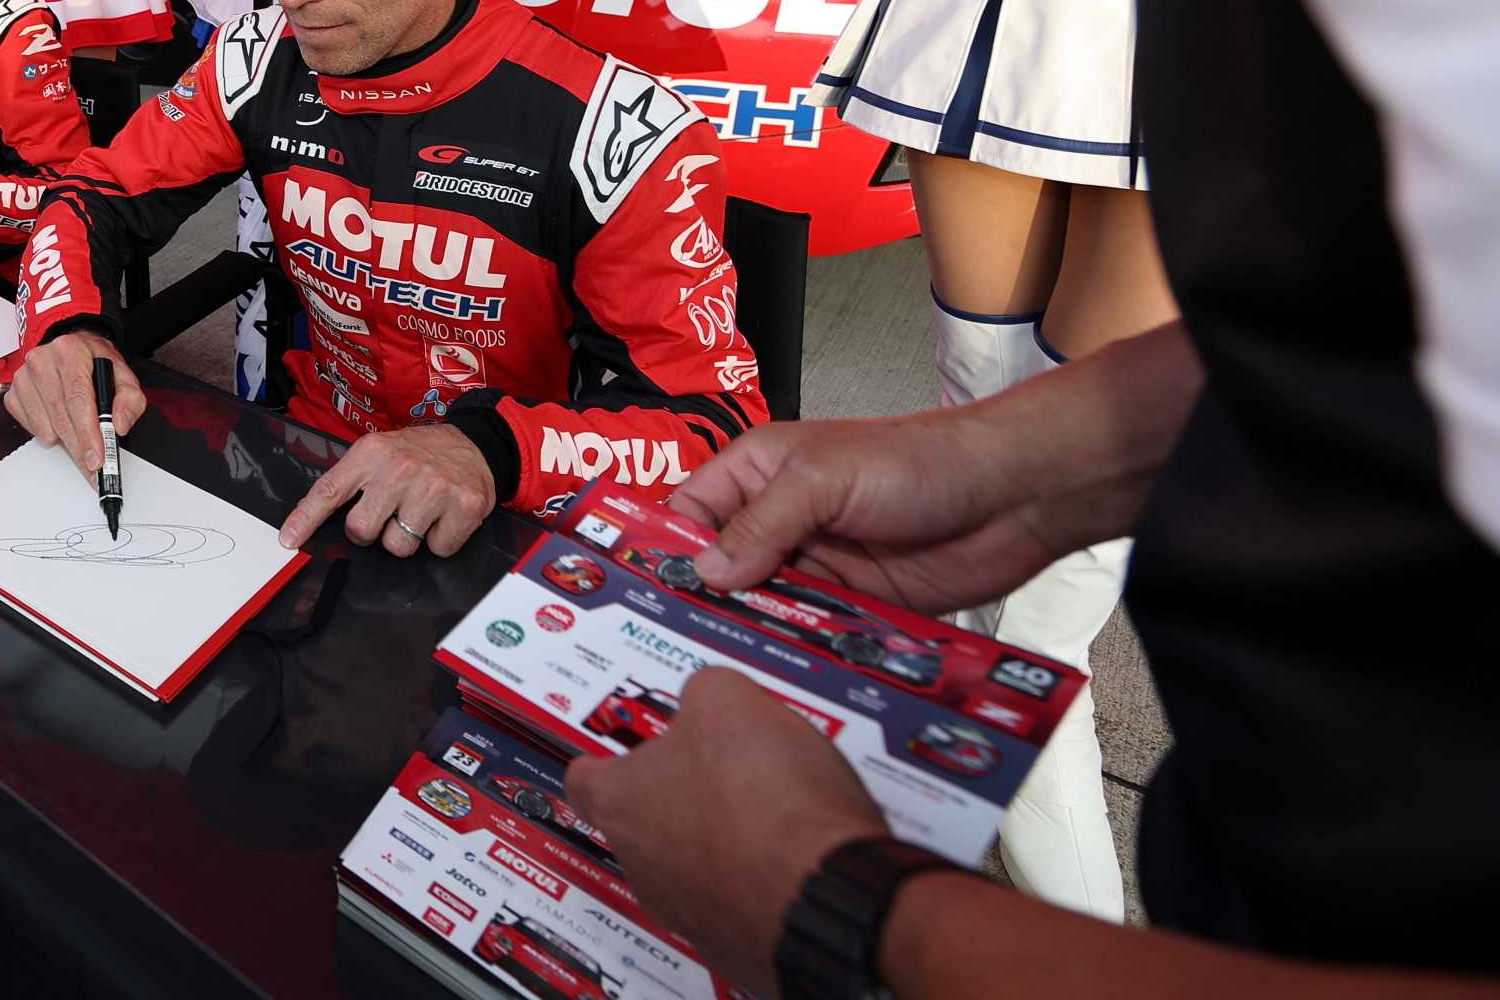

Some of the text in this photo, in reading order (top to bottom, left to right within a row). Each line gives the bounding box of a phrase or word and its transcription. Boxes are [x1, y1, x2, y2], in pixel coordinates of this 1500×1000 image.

[340, 83, 433, 100] NISSAN
[464, 156, 540, 178] SUPER GT
[413, 170, 533, 208] BRIDGESTONE
[282, 177, 507, 289] MOTUL
[285, 238, 506, 322] AUTECH
[397, 314, 506, 348] COSMO FOODS
[540, 426, 691, 487] MOTUL
[453, 751, 475, 770] 23
[493, 846, 561, 895] MOTUL
[543, 841, 602, 883] NISSAN
[445, 867, 488, 898] Jatco
[583, 907, 682, 971] AUTECH
